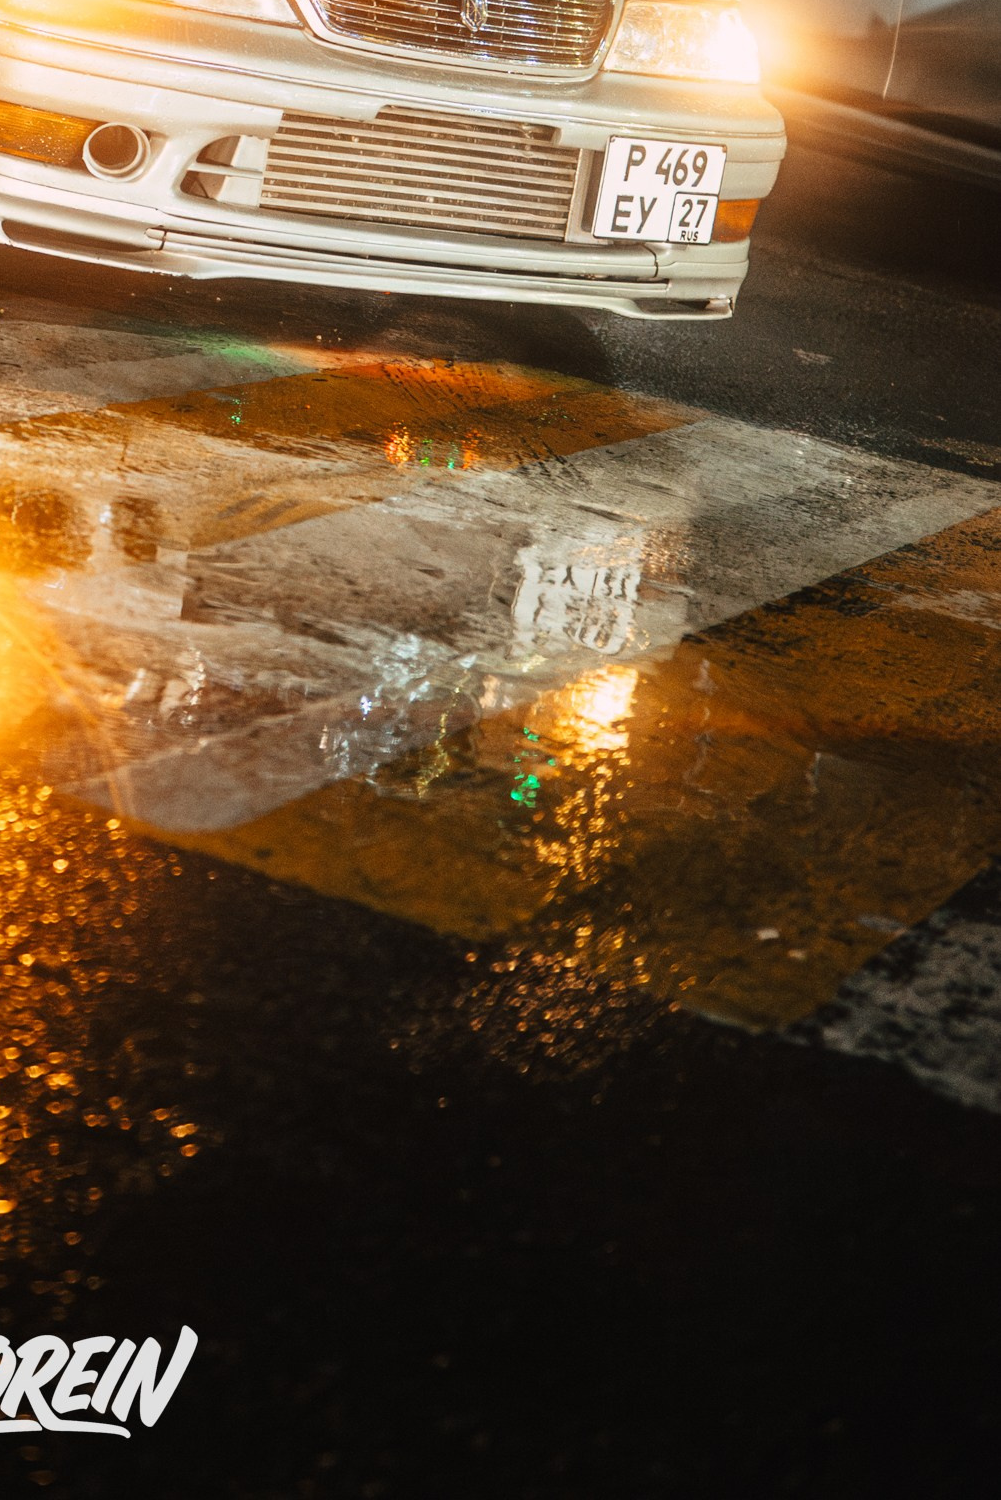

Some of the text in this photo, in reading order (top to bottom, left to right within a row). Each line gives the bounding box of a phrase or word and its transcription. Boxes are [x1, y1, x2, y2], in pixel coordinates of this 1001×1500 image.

[655, 148, 708, 187] 469
[679, 199, 708, 228] 27
[680, 230, 699, 241] RUS
